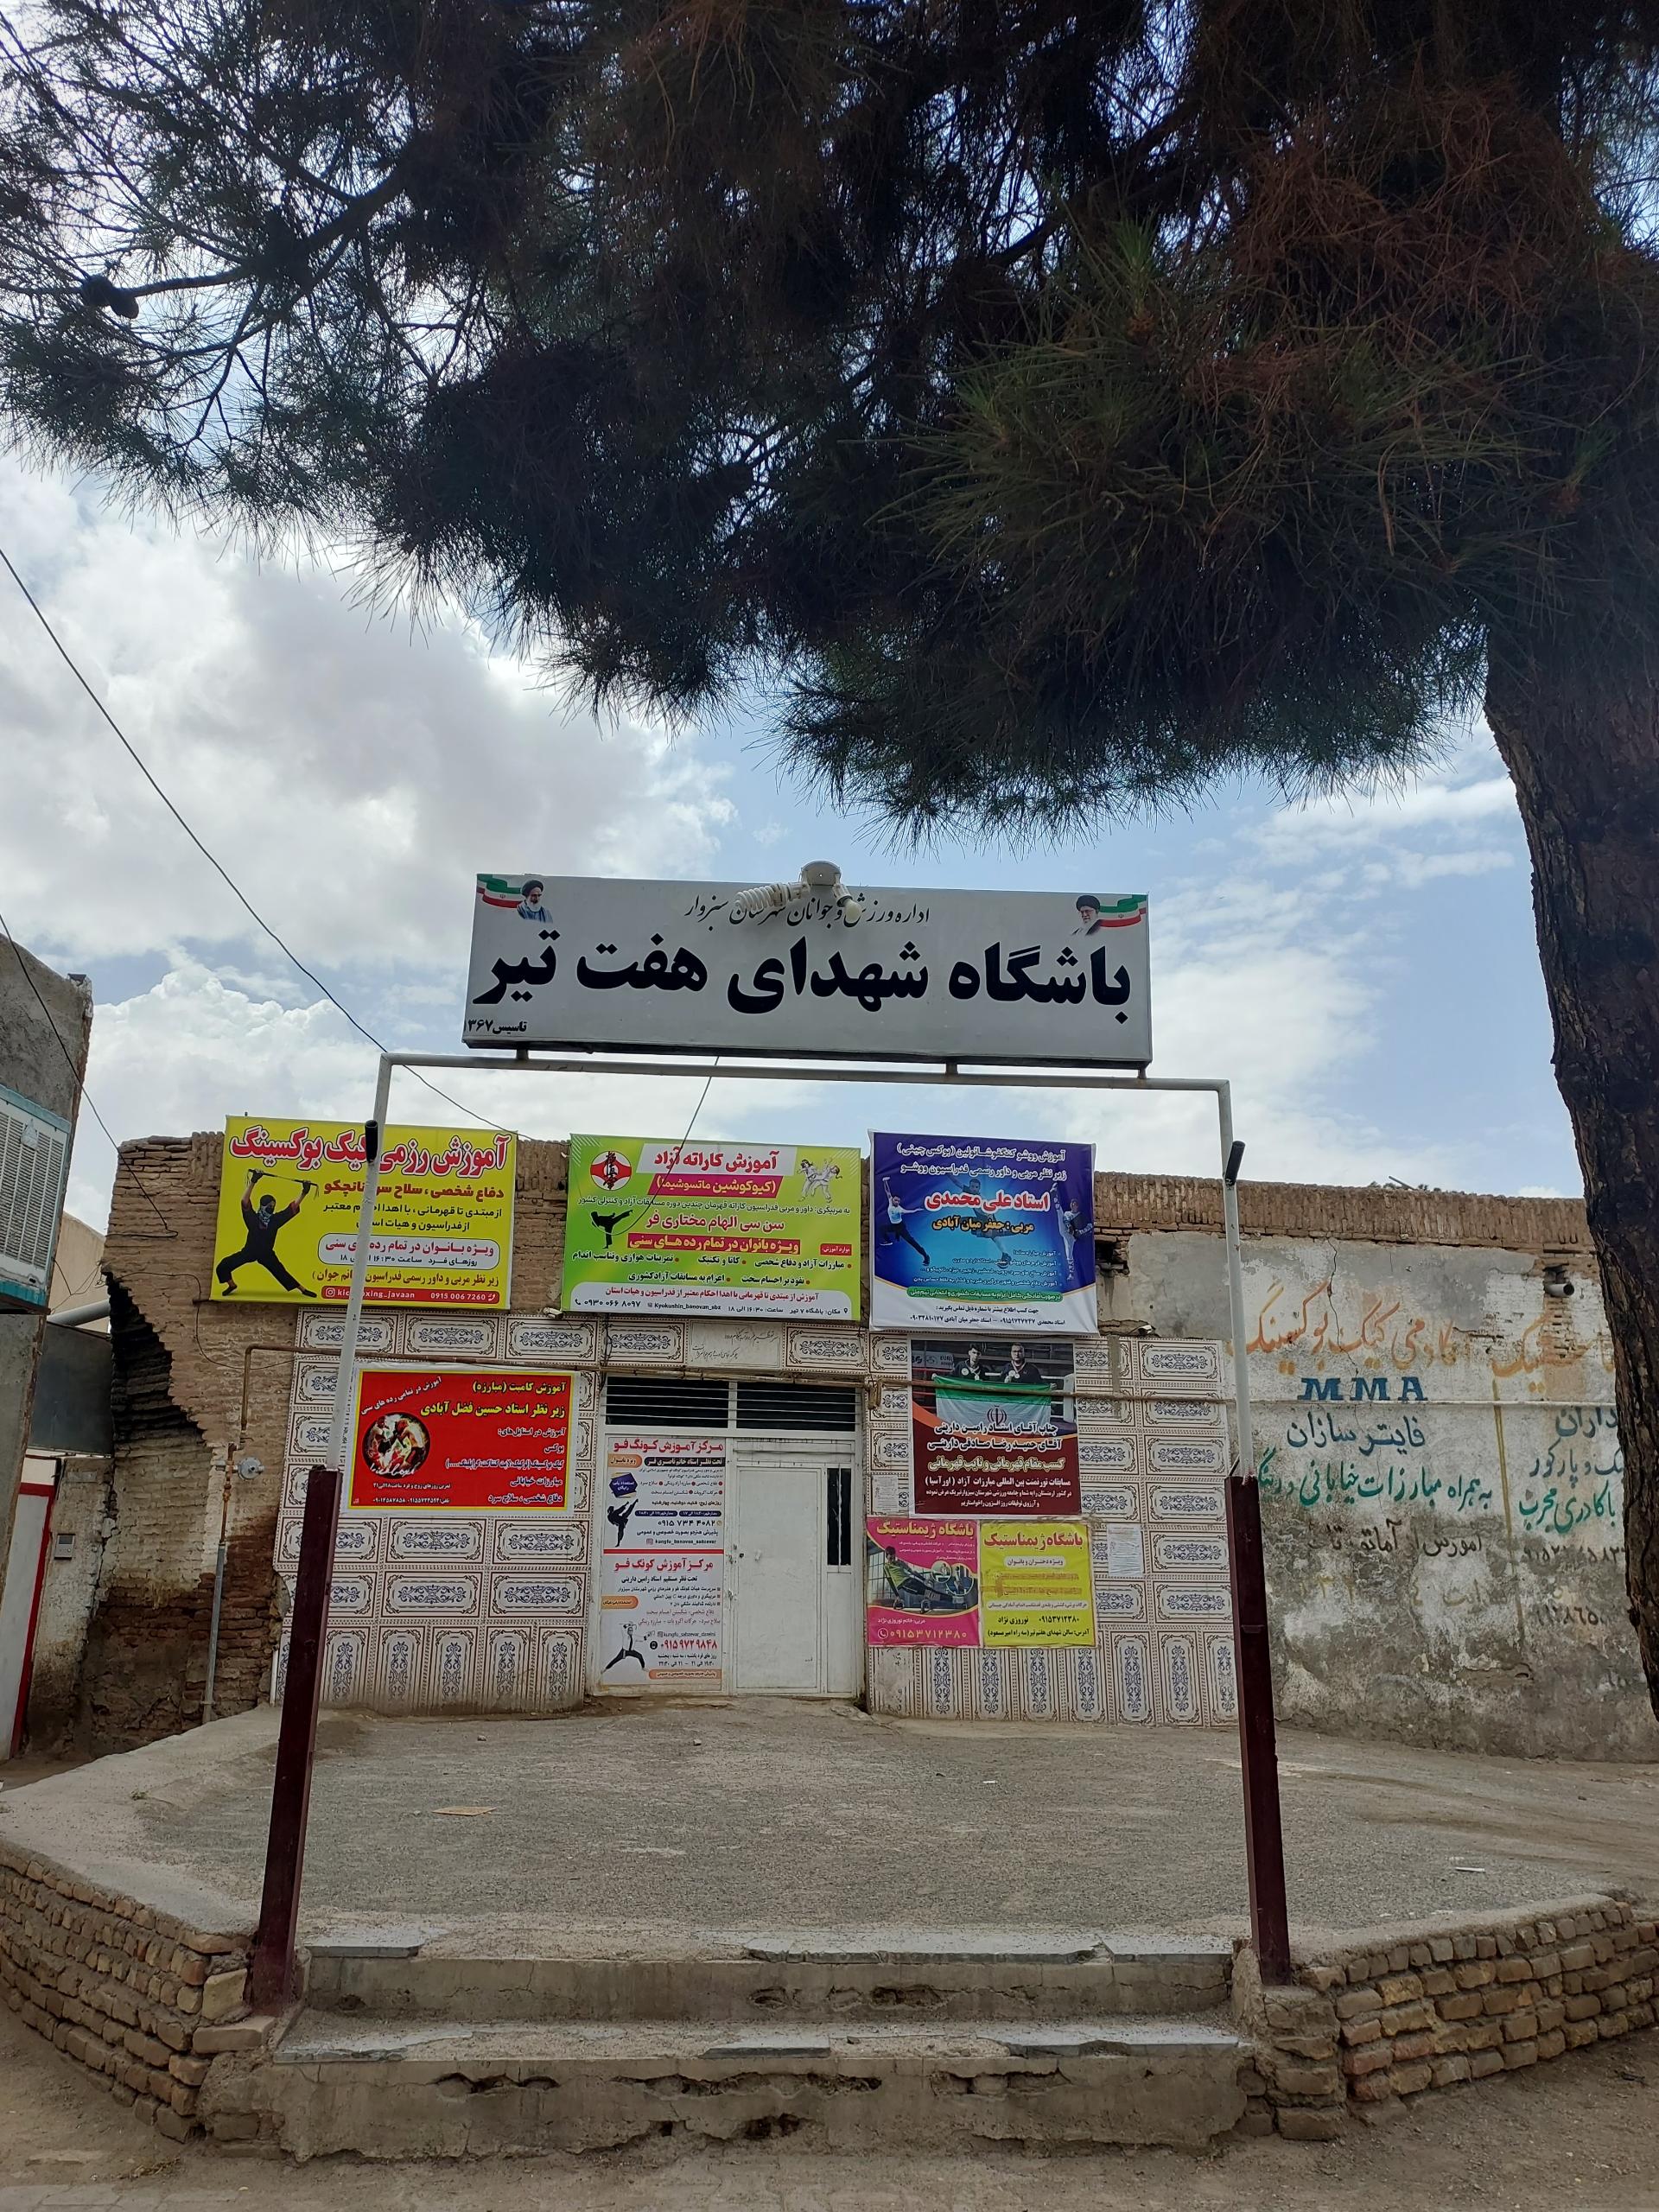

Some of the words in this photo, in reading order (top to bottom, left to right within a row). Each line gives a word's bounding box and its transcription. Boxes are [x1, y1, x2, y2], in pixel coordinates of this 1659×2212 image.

[684, 894, 728, 931] سبزوار
[786, 897, 834, 929] جوانان
[895, 904, 930, 924] اداره
[472, 929, 560, 1006] تیر
[576, 933, 709, 992] هفت
[727, 936, 931, 1014] شهدای
[948, 943, 1130, 1026] باشگاه
[230, 1125, 324, 1171] بوکسینگ
[378, 1138, 431, 1176] رزمی
[431, 1134, 512, 1179] آموزش
[654, 1146, 682, 1170] آزاد
[683, 1151, 724, 1172] کاراته
[726, 1150, 779, 1173] آموزش
[1039, 1148, 1066, 1164] آموزش
[900, 1160, 928, 1174] ووشو
[928, 1163, 969, 1176] فدراسیون
[995, 1166, 1012, 1179] داور
[1018, 1171, 1038, 1180] مربی
[1038, 1169, 1053, 1181] نظر
[1054, 1171, 1067, 1181] زیر
[324, 1179, 365, 1197] نانچکو
[393, 1184, 423, 1198] سلاح
[430, 1185, 474, 1198] شخصی
[475, 1186, 505, 1202] دفاع
[577, 1194, 598, 1205] کشور
[681, 1200, 703, 1210] چندین
[925, 1190, 982, 1211] محمدی
[982, 1189, 1012, 1213] علی
[1014, 1191, 1050, 1211] استاد
[323, 1202, 352, 1212] معتبر
[417, 1204, 455, 1217] قهرمانی
[466, 1207, 494, 1218] مبتدی
[385, 1219, 410, 1230] هیات
[645, 1209, 660, 1228] فر
[662, 1212, 706, 1230] مختاری
[707, 1214, 738, 1232] الهام
[932, 1215, 961, 1230] آبادی
[960, 1217, 982, 1232] میان
[419, 1221, 462, 1231] فدراسیون
[740, 1220, 760, 1233] سی
[762, 1220, 785, 1234] سن
[983, 1219, 1006, 1234] جعفر
[325, 1241, 346, 1251] سنی
[369, 1242, 386, 1253] رده
[388, 1240, 407, 1254] تمام
[409, 1243, 421, 1254] در
[422, 1242, 464, 1255] بانوان
[628, 1235, 653, 1249] سنی
[653, 1235, 683, 1249] های
[683, 1238, 702, 1250] رده
[702, 1236, 725, 1252] تمام
[724, 1238, 739, 1252] در
[739, 1237, 769, 1253] بانوان
[770, 1239, 799, 1255] ویژه
[466, 1243, 494, 1256] ویژه
[572, 1249, 592, 1260] اندام
[448, 1256, 478, 1267] روزهای
[620, 1253, 645, 1263] هوازی
[754, 1257, 779, 1268] شخصی
[780, 1258, 797, 1268] دفاع
[803, 1257, 818, 1269] آزاد
[818, 1259, 845, 1270] مبارزات
[364, 1269, 402, 1285] فدراسیون
[404, 1273, 426, 1285] رسمی
[427, 1273, 443, 1285] داور
[450, 1276, 470, 1287] مربی
[469, 1274, 486, 1287] نظر
[486, 1275, 499, 1287] زیر
[621, 1299, 642, 1307] ۸۰۹۷
[536, 1382, 566, 1394] آموزش
[1296, 1376, 1428, 1402] MMA
[420, 1401, 450, 1417] آبادی
[451, 1402, 474, 1415] فضل
[475, 1405, 503, 1417] حسین
[505, 1402, 529, 1414] استاد
[530, 1404, 549, 1418] نظر
[550, 1406, 565, 1418] زیر
[961, 1422, 988, 1435] رامین
[1013, 1421, 1037, 1435] آقای
[1038, 1423, 1058, 1436] جناب
[1287, 1410, 1357, 1448] سازان
[1358, 1414, 1426, 1456] فایتر
[613, 1438, 629, 1452] فو
[629, 1437, 658, 1452] کونگ
[658, 1440, 696, 1453] آموزش
[696, 1440, 724, 1453] مرکز
[959, 1437, 991, 1451] صادقی
[1013, 1440, 1037, 1451] حمید
[1038, 1438, 1063, 1452] آقای
[927, 1454, 965, 1472] قهرمانی
[1042, 1456, 1066, 1471] کسب
[1299, 1459, 1359, 1506] خیابانی
[1357, 1465, 1442, 1508] مبارزات
[546, 1493, 563, 1505] دفاع
[1447, 1474, 1481, 1512] همراه
[876, 1521, 937, 1539] ژیمناستیک
[938, 1522, 975, 1540] باشگاه
[983, 1531, 1047, 1551] ژیمناستیک
[1046, 1532, 1084, 1549] باشگاه
[614, 1557, 631, 1572] فو
[632, 1558, 655, 1572] کونگ
[656, 1557, 687, 1572] آموزش
[687, 1558, 714, 1572] مرکز
